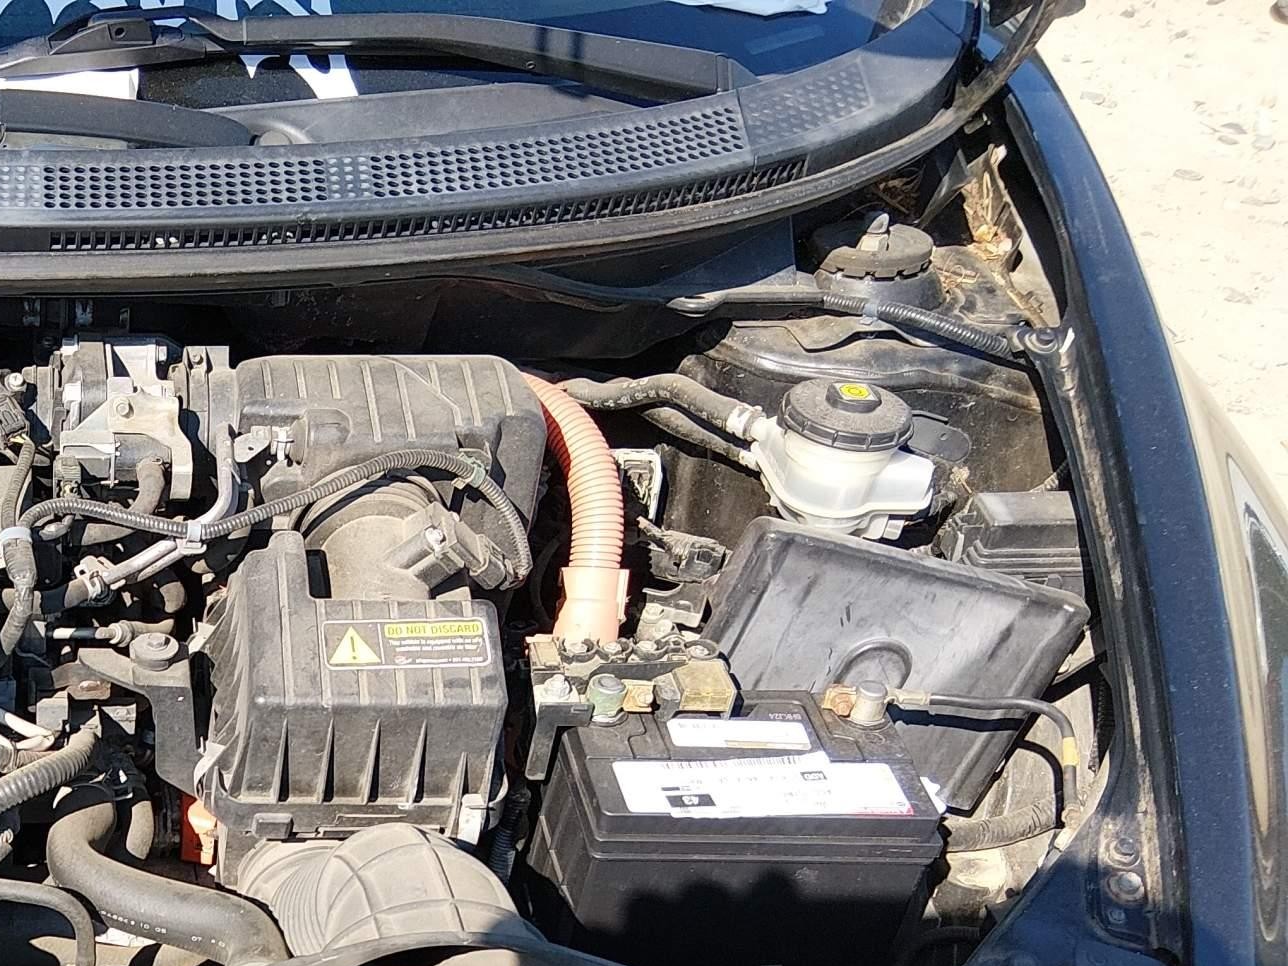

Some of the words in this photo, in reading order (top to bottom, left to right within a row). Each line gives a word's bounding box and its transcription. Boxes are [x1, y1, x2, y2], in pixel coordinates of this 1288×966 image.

[387, 625, 403, 636] DO
[406, 625, 427, 635] NOT
[431, 623, 480, 635] DISCARD
